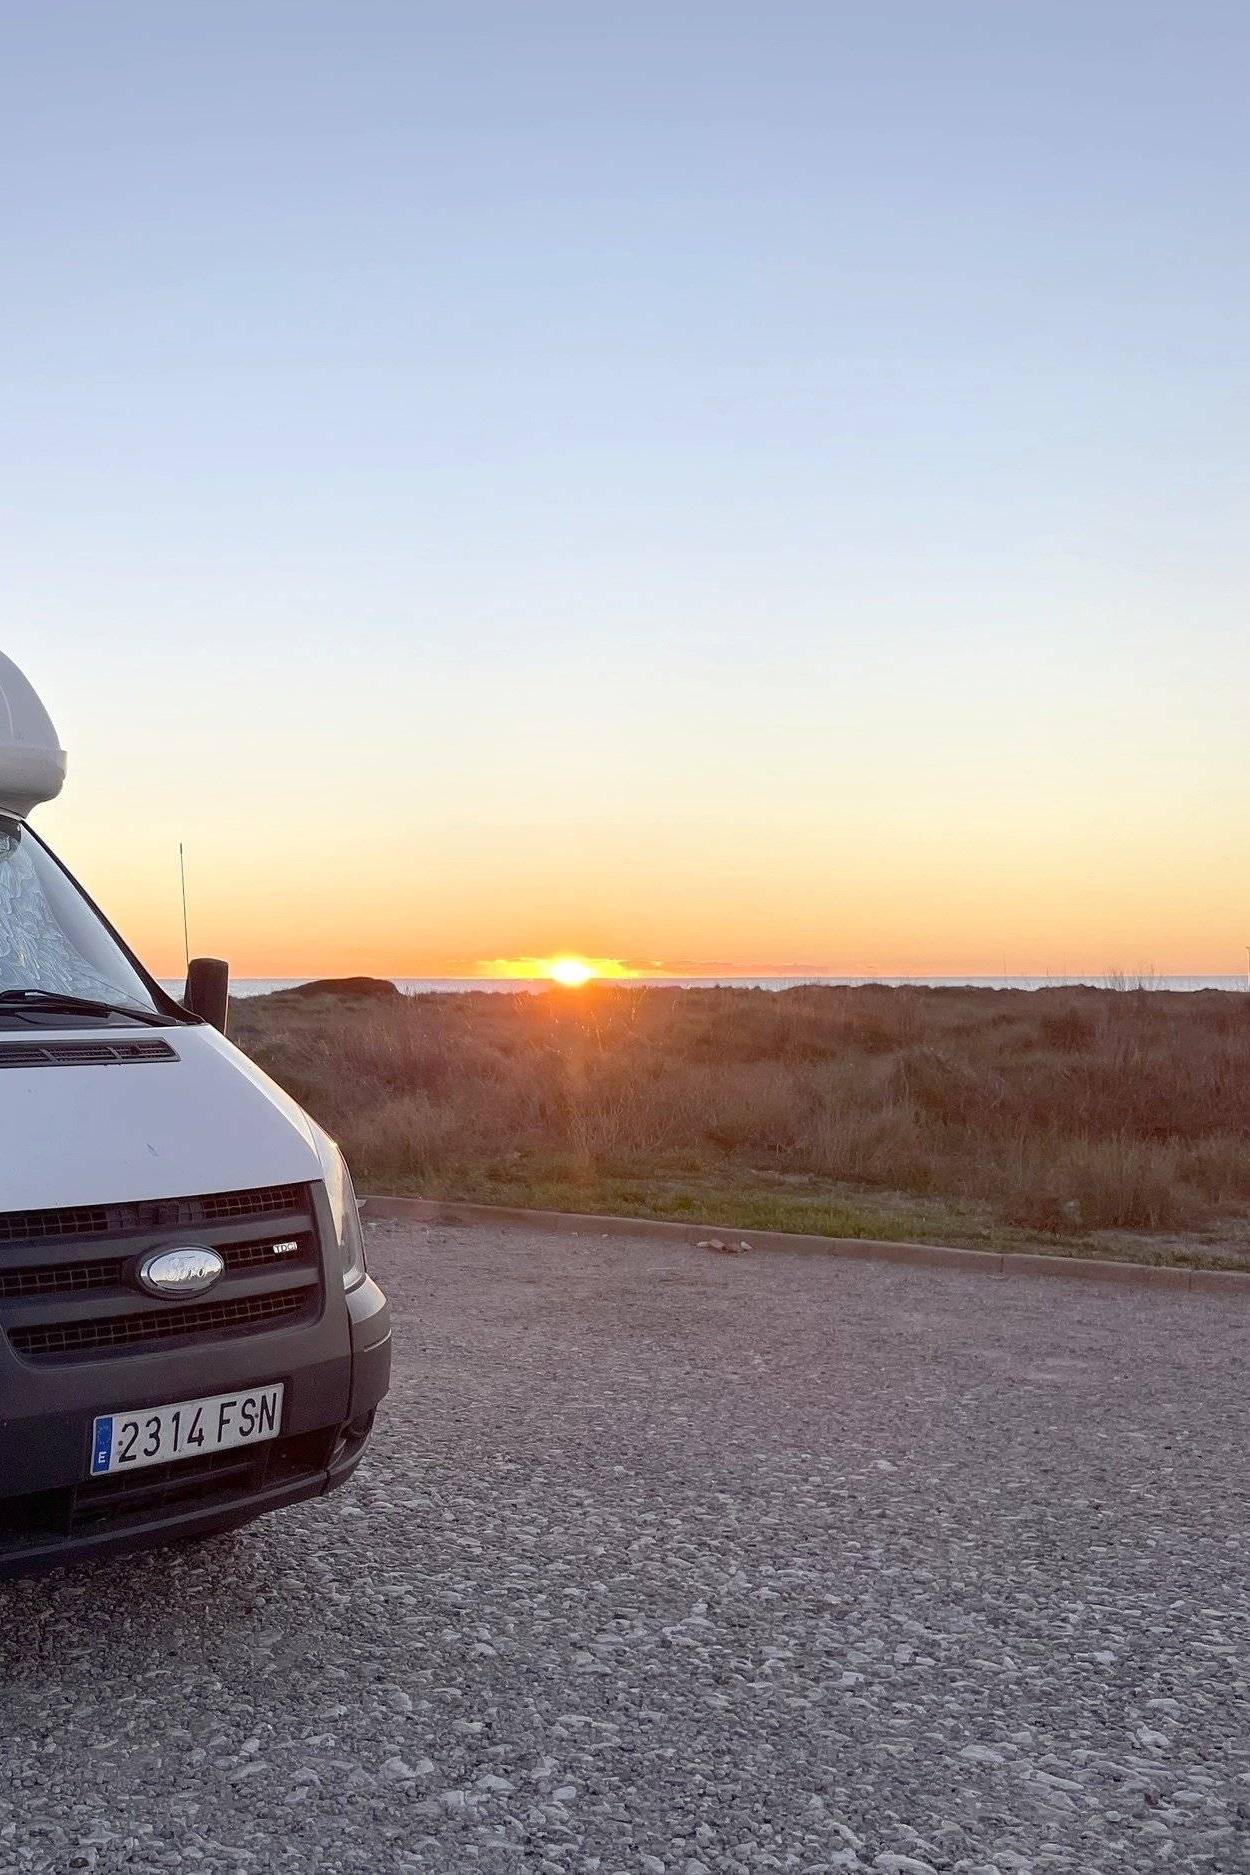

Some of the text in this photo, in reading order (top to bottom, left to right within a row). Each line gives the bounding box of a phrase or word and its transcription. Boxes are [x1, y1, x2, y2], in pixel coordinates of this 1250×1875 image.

[97, 1392, 277, 1464] E 2314 FSN
